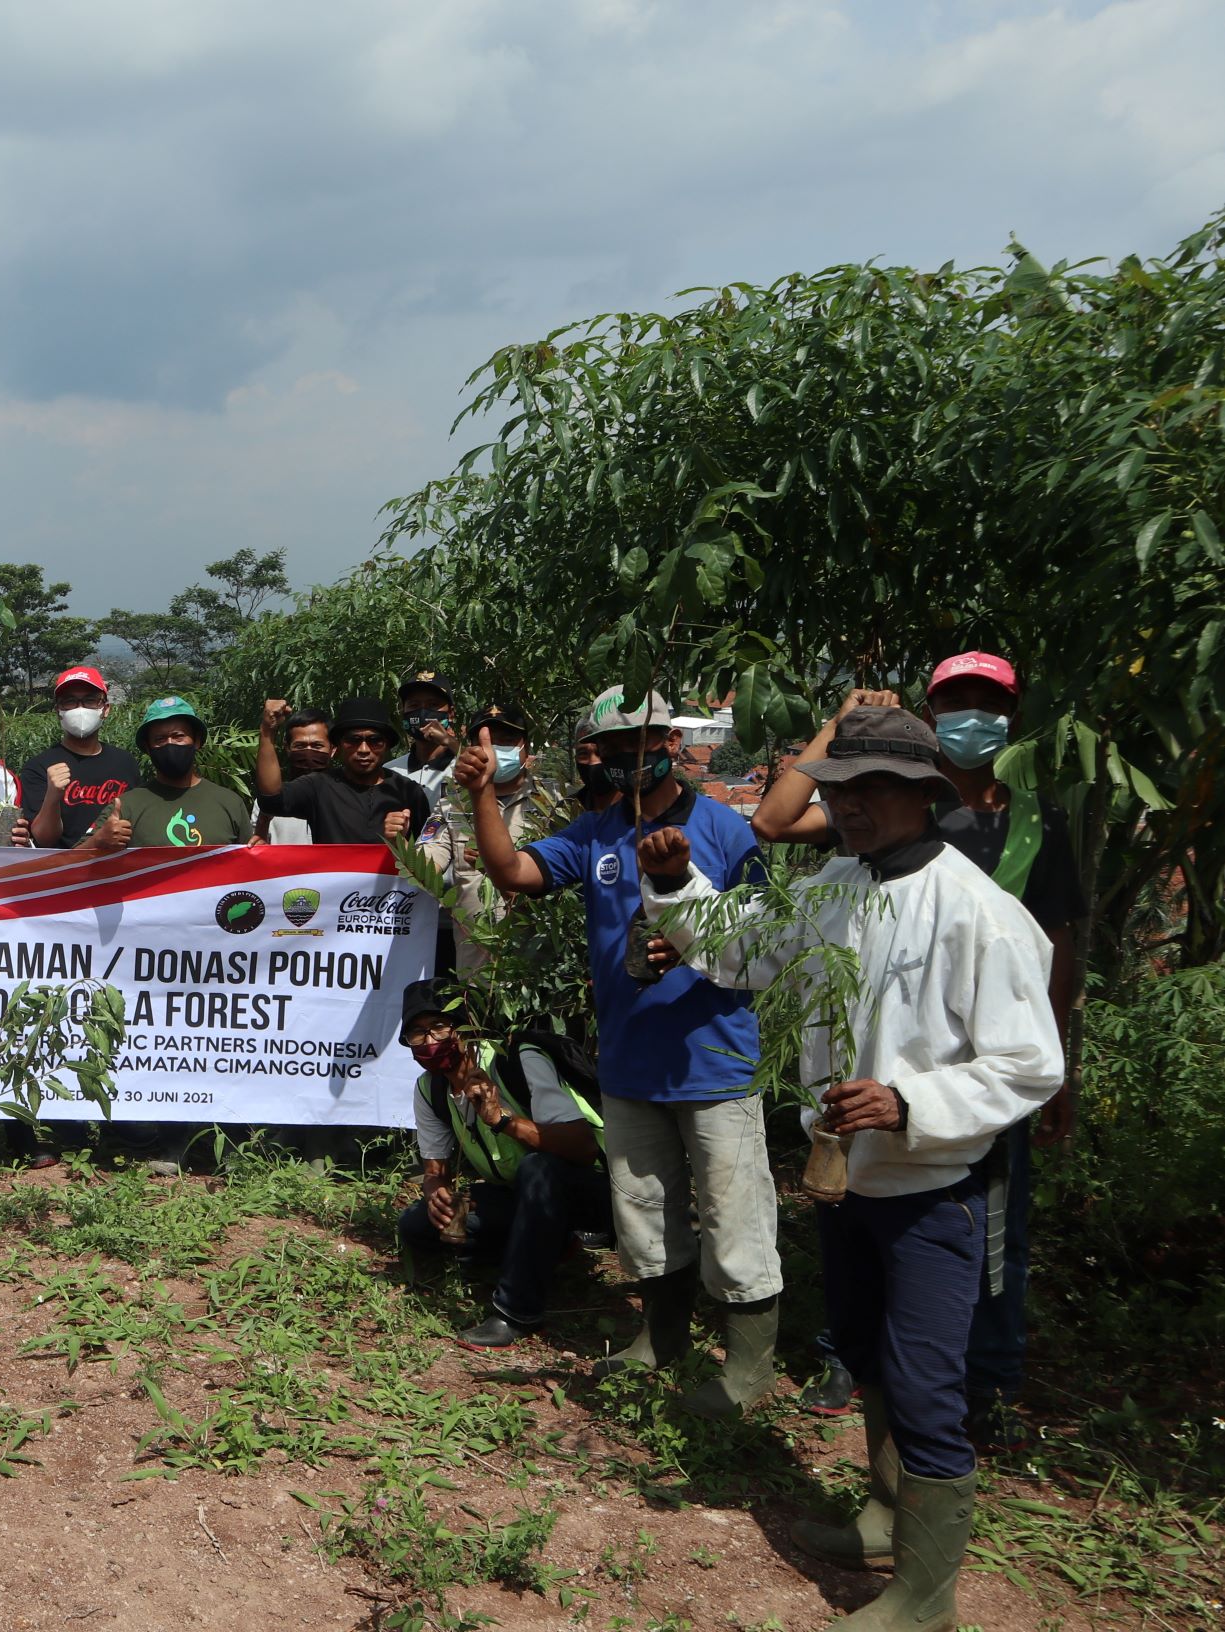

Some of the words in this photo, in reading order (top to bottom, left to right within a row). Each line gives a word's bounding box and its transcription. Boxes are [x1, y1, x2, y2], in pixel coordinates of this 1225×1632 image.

[63, 779, 129, 806] Coca-Col
[339, 890, 418, 914] Coca-Cola
[336, 924, 411, 936] PARTNERS
[337, 915, 412, 925] EUROPACIFIC
[102, 946, 124, 980] /
[134, 947, 257, 985] DONASI
[268, 950, 383, 991] POHON
[165, 991, 292, 1031] FOREST
[154, 1035, 257, 1054] PARTNERS
[263, 1039, 378, 1059] INDONESIA
[214, 1057, 362, 1079] CIMANGGUNG
[124, 1090, 142, 1102] 30
[147, 1090, 179, 1103] JUNI
[183, 1091, 214, 1104] 2021
